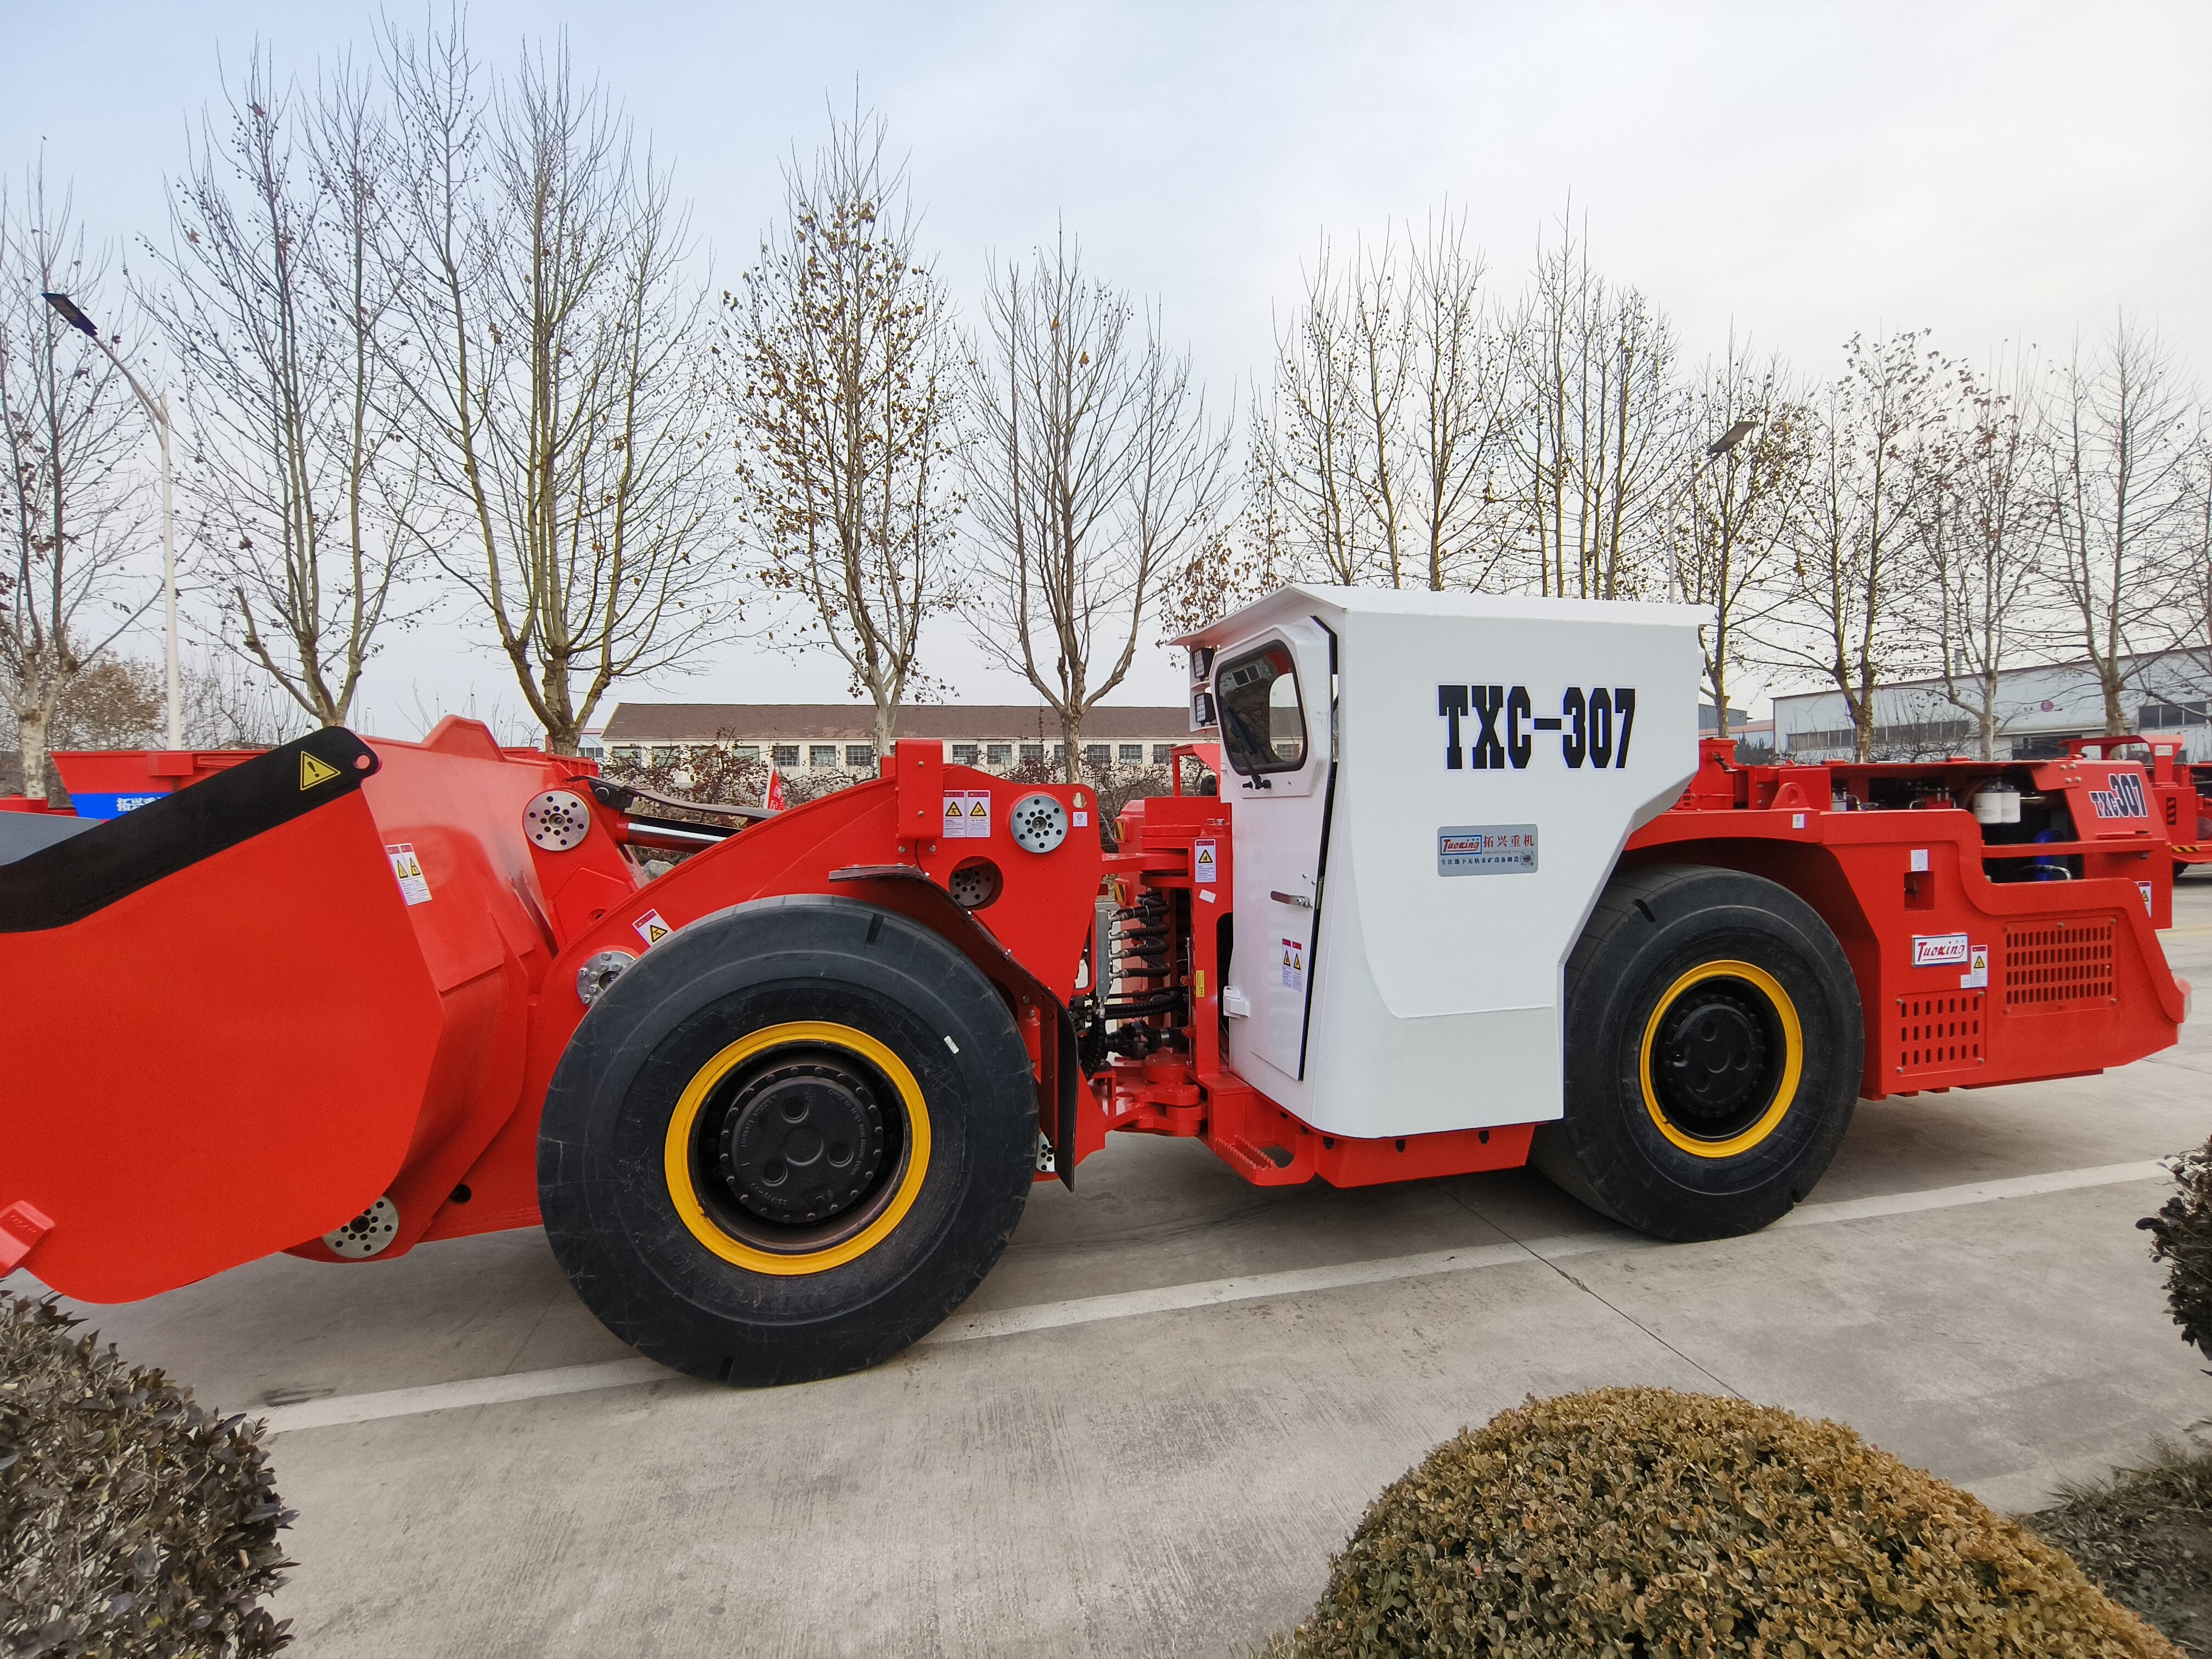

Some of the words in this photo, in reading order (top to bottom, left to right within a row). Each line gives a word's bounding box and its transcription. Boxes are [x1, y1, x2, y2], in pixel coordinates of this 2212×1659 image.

[1437, 685, 1636, 770] TXC-307
[2088, 773, 2148, 819] TXC307
[1483, 834, 1534, 848] 拓兴重机
[1442, 856, 1519, 865] 专注地下无轨采矿设备制造
[1917, 940, 1966, 962] Tuoxing
